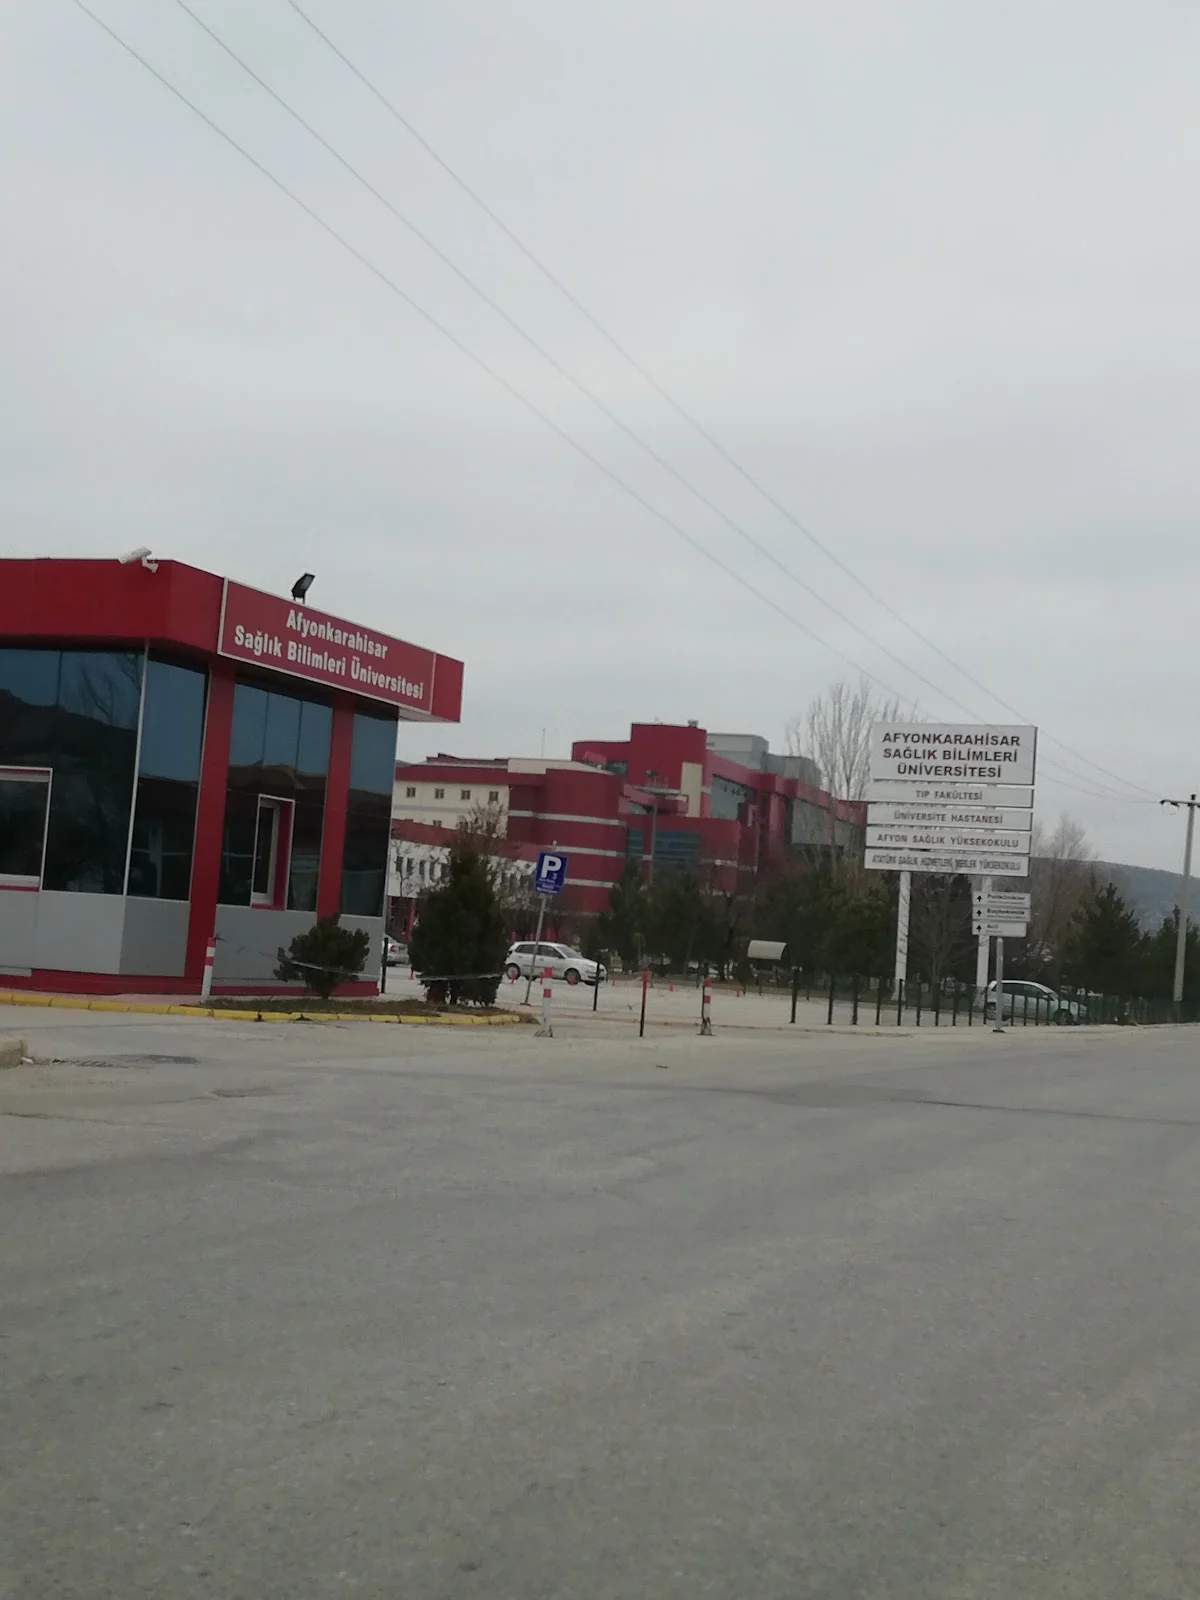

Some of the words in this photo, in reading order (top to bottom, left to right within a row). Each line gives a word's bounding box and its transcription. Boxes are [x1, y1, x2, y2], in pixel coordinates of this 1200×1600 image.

[286, 609, 388, 660] Afyonkarahisar
[234, 625, 283, 657] Sağlık
[287, 641, 347, 676] Bilimleri
[350, 656, 424, 700] Üniversitesi
[882, 732, 1021, 747] AFYONKARAHİSAR
[882, 747, 937, 760] SAĞLIK
[942, 749, 1018, 763] BİLİMLERİ
[897, 764, 1002, 778] ÜNİVERSİTESİ
[915, 790, 930, 799] TIP
[934, 790, 983, 801] FAKÜLTESİ
[893, 811, 946, 822] ÜNİVERSİTE
[951, 814, 1003, 824] HASTANESİ
[876, 833, 907, 843] AFYON
[912, 834, 945, 845] SAĞLIK
[950, 837, 1019, 848] YÜKSEKOKULU
[540, 855, 562, 878] P
